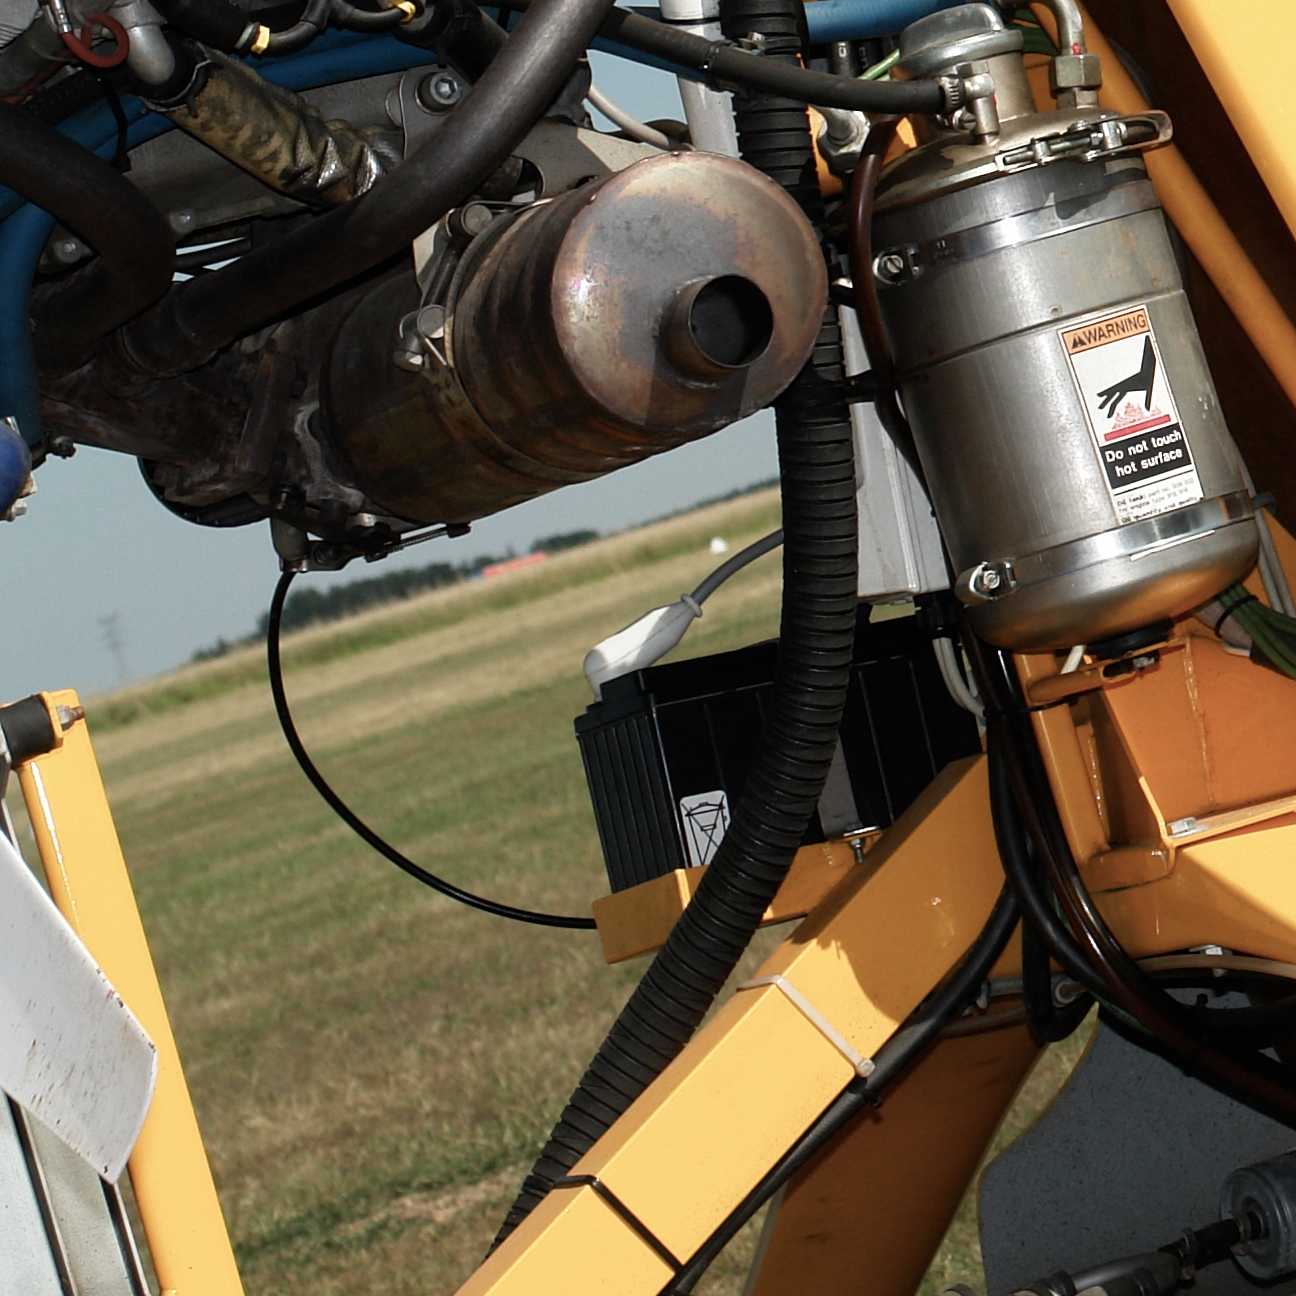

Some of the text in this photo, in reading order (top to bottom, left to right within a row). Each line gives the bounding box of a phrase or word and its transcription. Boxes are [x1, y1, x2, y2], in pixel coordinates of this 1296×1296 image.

[1084, 313, 1147, 342] WARNING
[1104, 430, 1182, 463] Do not touch
[1115, 448, 1183, 477] hot surface
